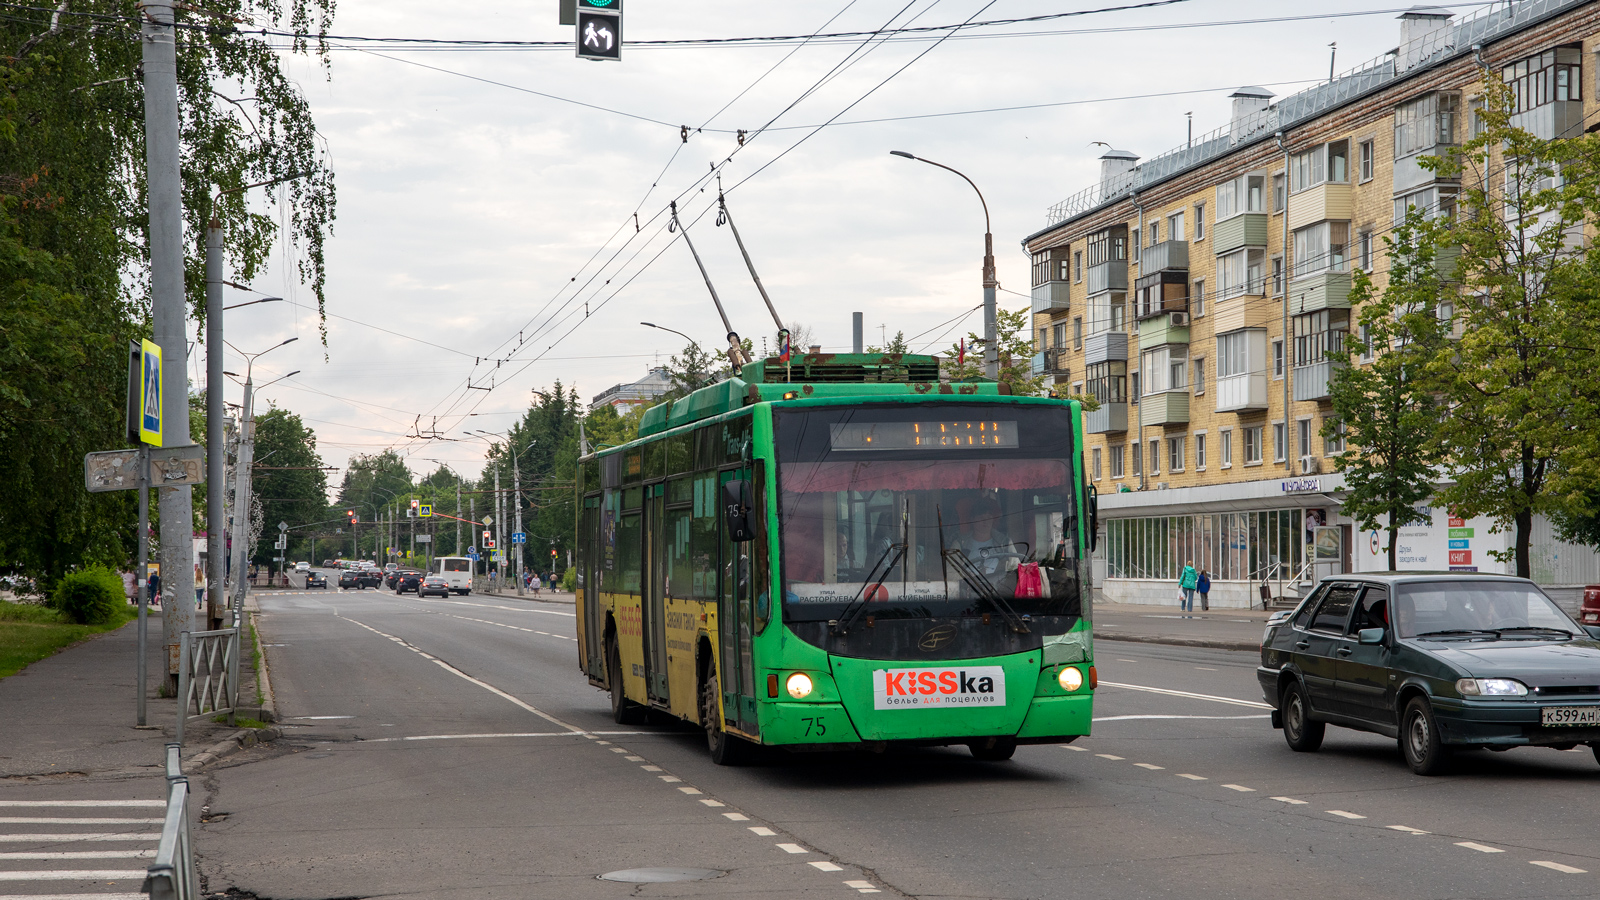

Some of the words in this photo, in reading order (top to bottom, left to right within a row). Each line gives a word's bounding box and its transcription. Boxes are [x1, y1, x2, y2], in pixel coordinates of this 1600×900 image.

[728, 504, 739, 517] 75
[1450, 553, 1465, 563] КНИГ
[800, 595, 854, 603] РАСТОРГУЕВА
[945, 695, 995, 704] поцелуев
[801, 716, 826, 737] 75
